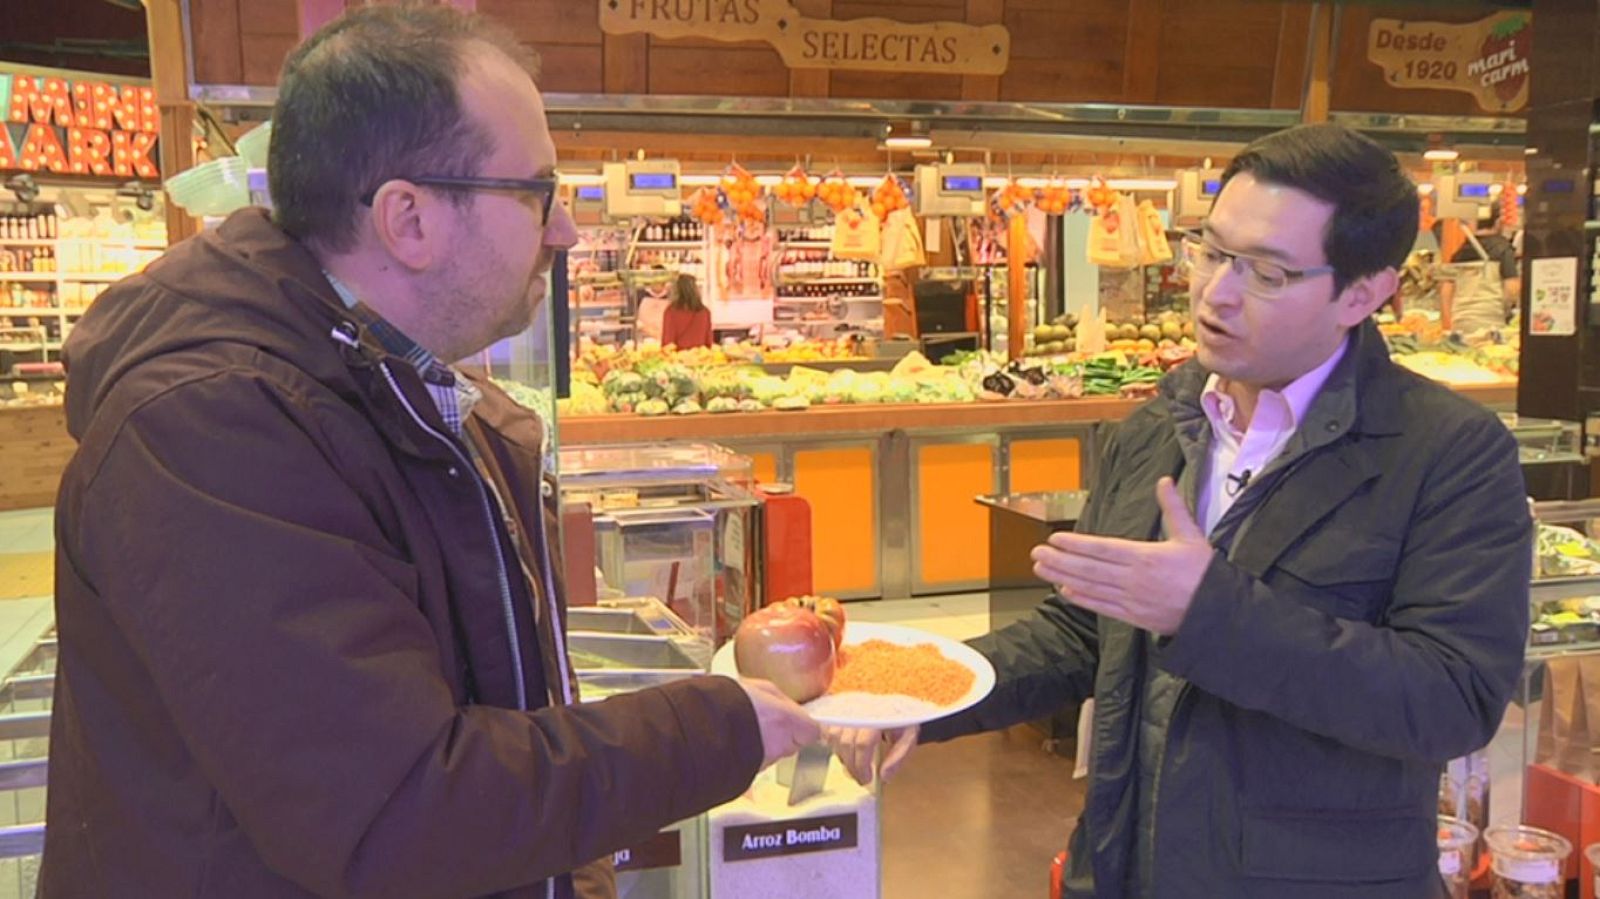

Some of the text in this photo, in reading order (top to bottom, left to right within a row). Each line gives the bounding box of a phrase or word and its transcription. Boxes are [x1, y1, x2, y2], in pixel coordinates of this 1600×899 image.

[629, 0, 761, 24] FRUTAS
[804, 31, 957, 64] SELECTAS
[1377, 30, 1447, 51] Desde
[1405, 61, 1457, 80] 1920
[1468, 40, 1516, 76] mari
[10, 75, 160, 132] MINI
[0, 122, 159, 177] ARK
[742, 826, 841, 851] Arroz Bomba
